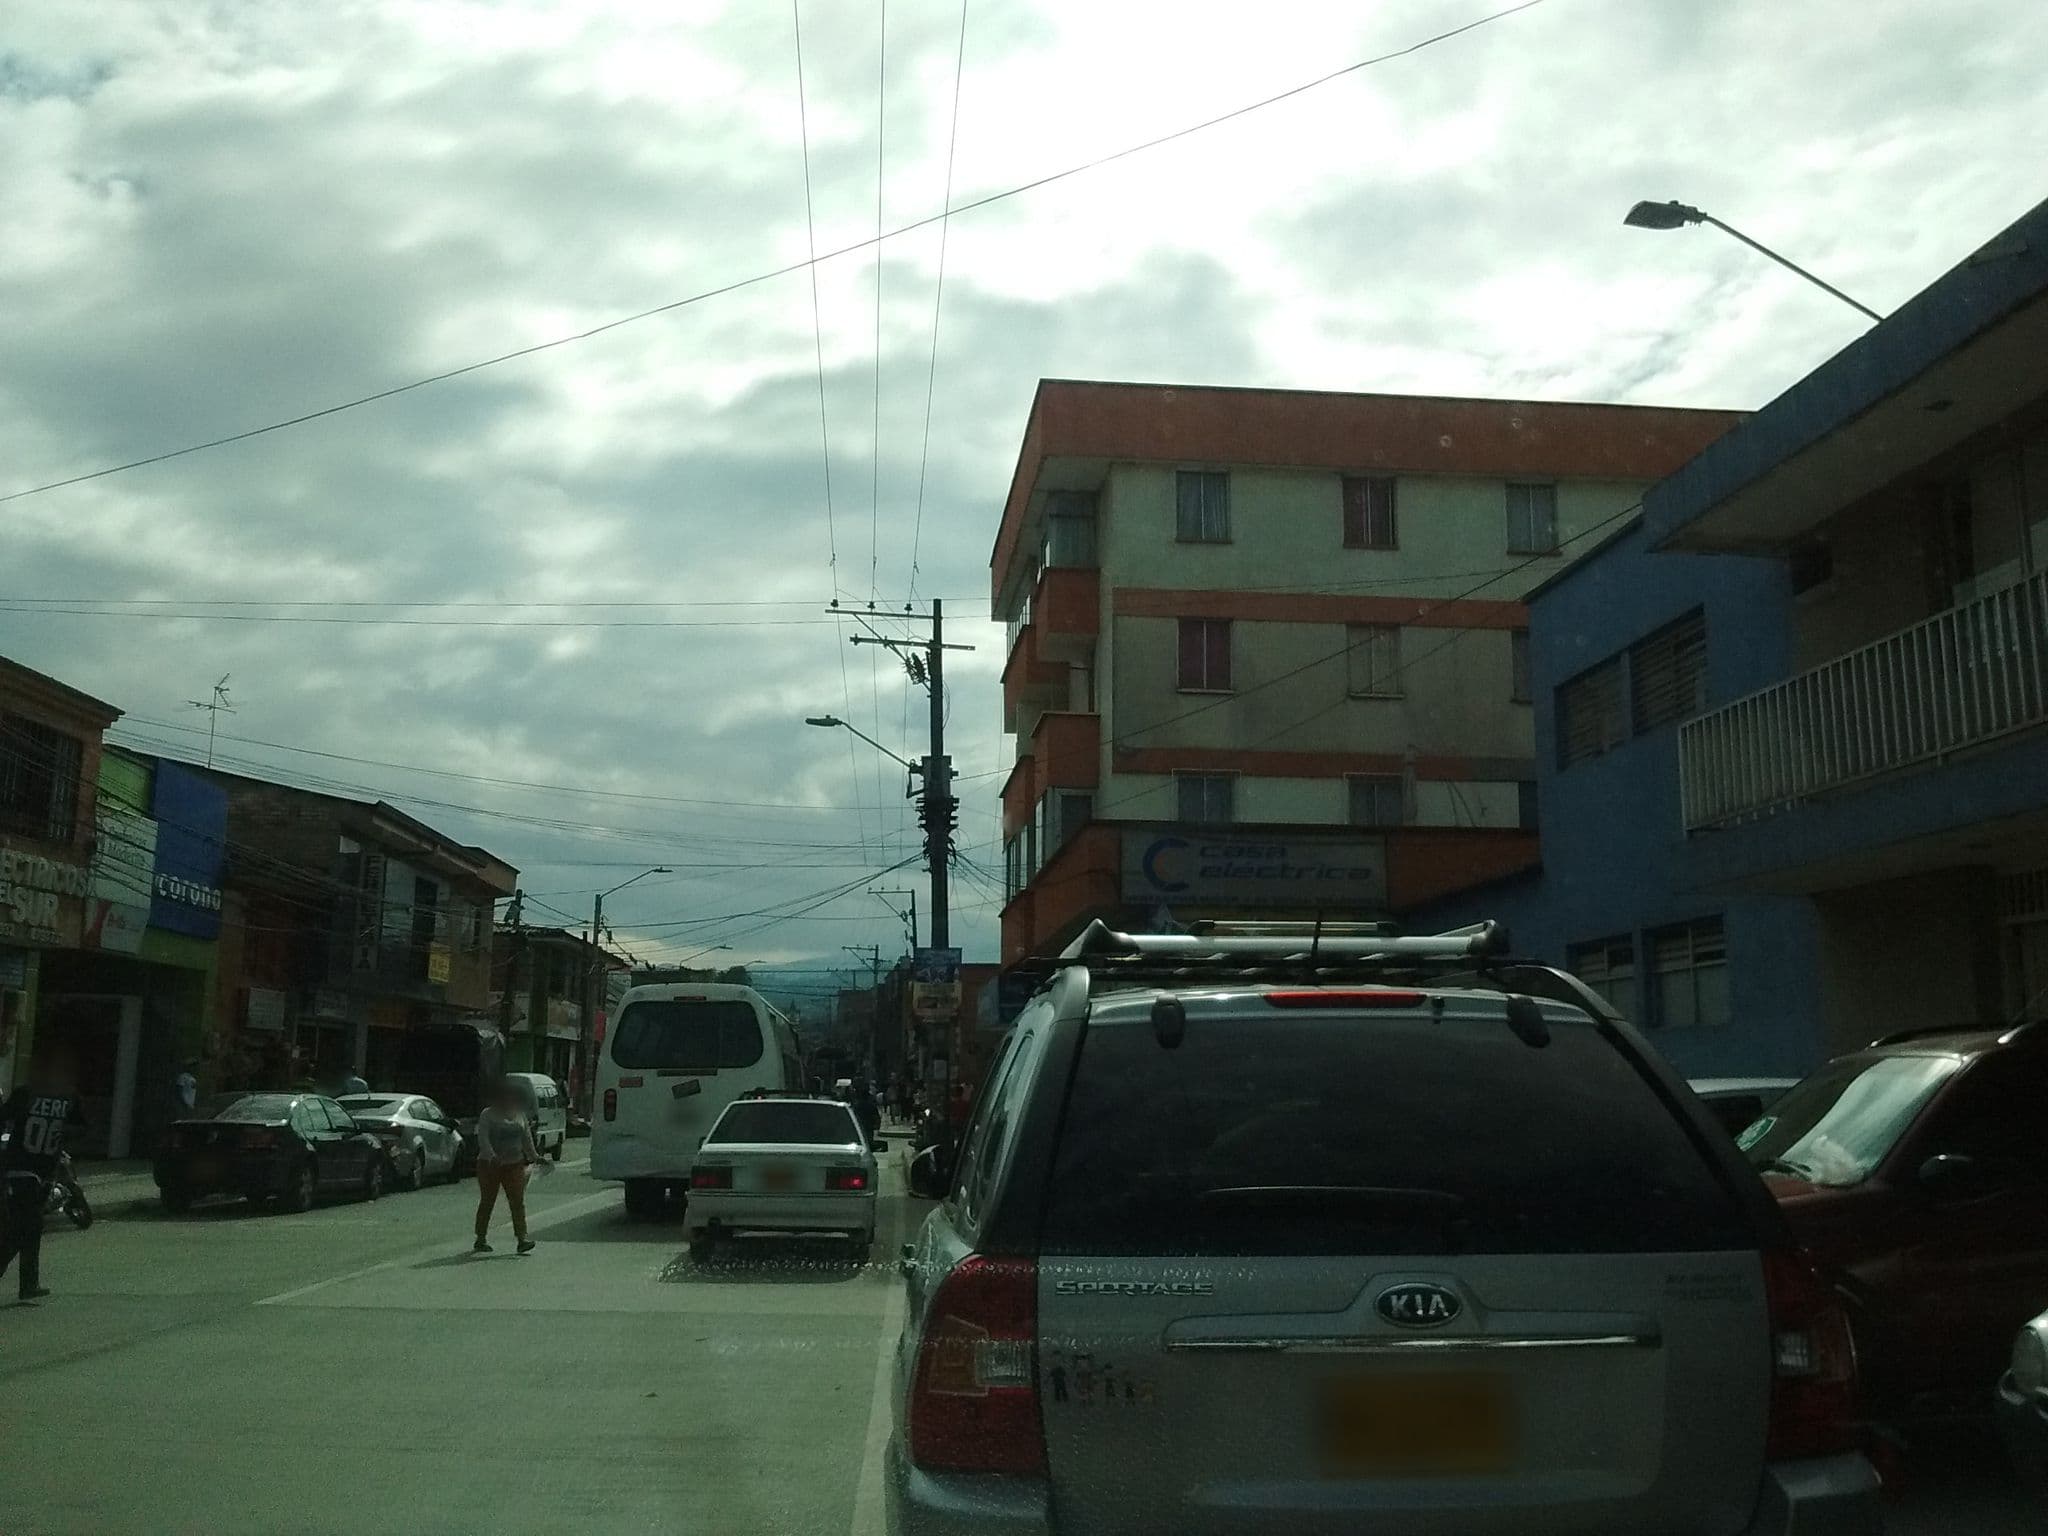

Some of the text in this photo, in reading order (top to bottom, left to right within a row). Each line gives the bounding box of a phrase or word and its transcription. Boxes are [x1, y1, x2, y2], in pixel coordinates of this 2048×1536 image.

[157, 872, 222, 911] corona
[1055, 1281, 1214, 1296] SPORTAGE
[1390, 1293, 1449, 1319] KIA
